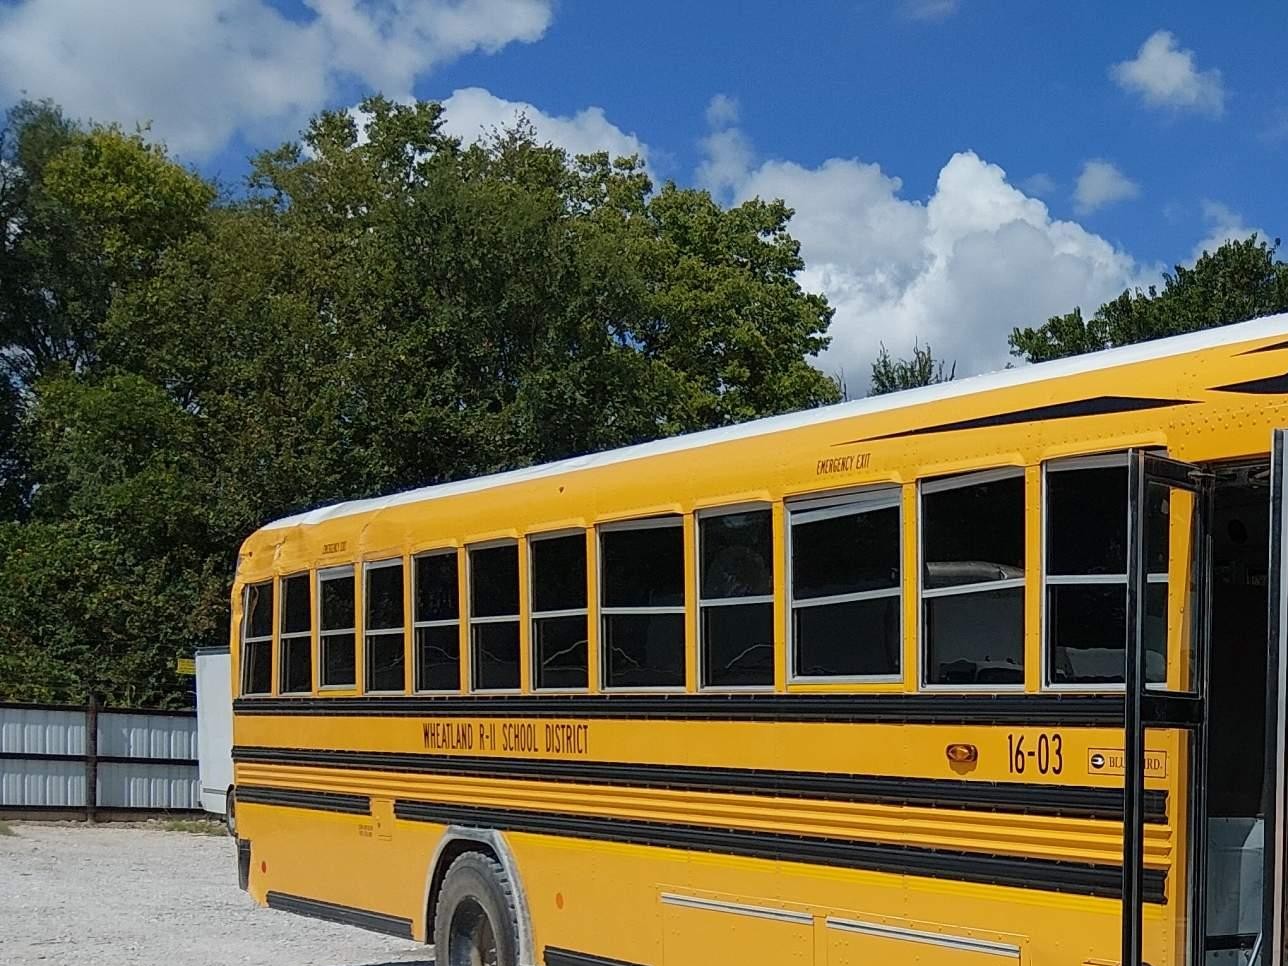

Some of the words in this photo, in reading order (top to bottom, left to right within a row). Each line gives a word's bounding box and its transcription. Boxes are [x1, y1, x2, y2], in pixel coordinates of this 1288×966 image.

[816, 455, 855, 476] EMERGENCY
[856, 452, 871, 470] EXIT
[422, 722, 473, 750] WHEATLAND
[502, 723, 539, 753] SCHOOL
[545, 723, 589, 754] DISTRICT
[1007, 733, 1064, 775] 16-03
